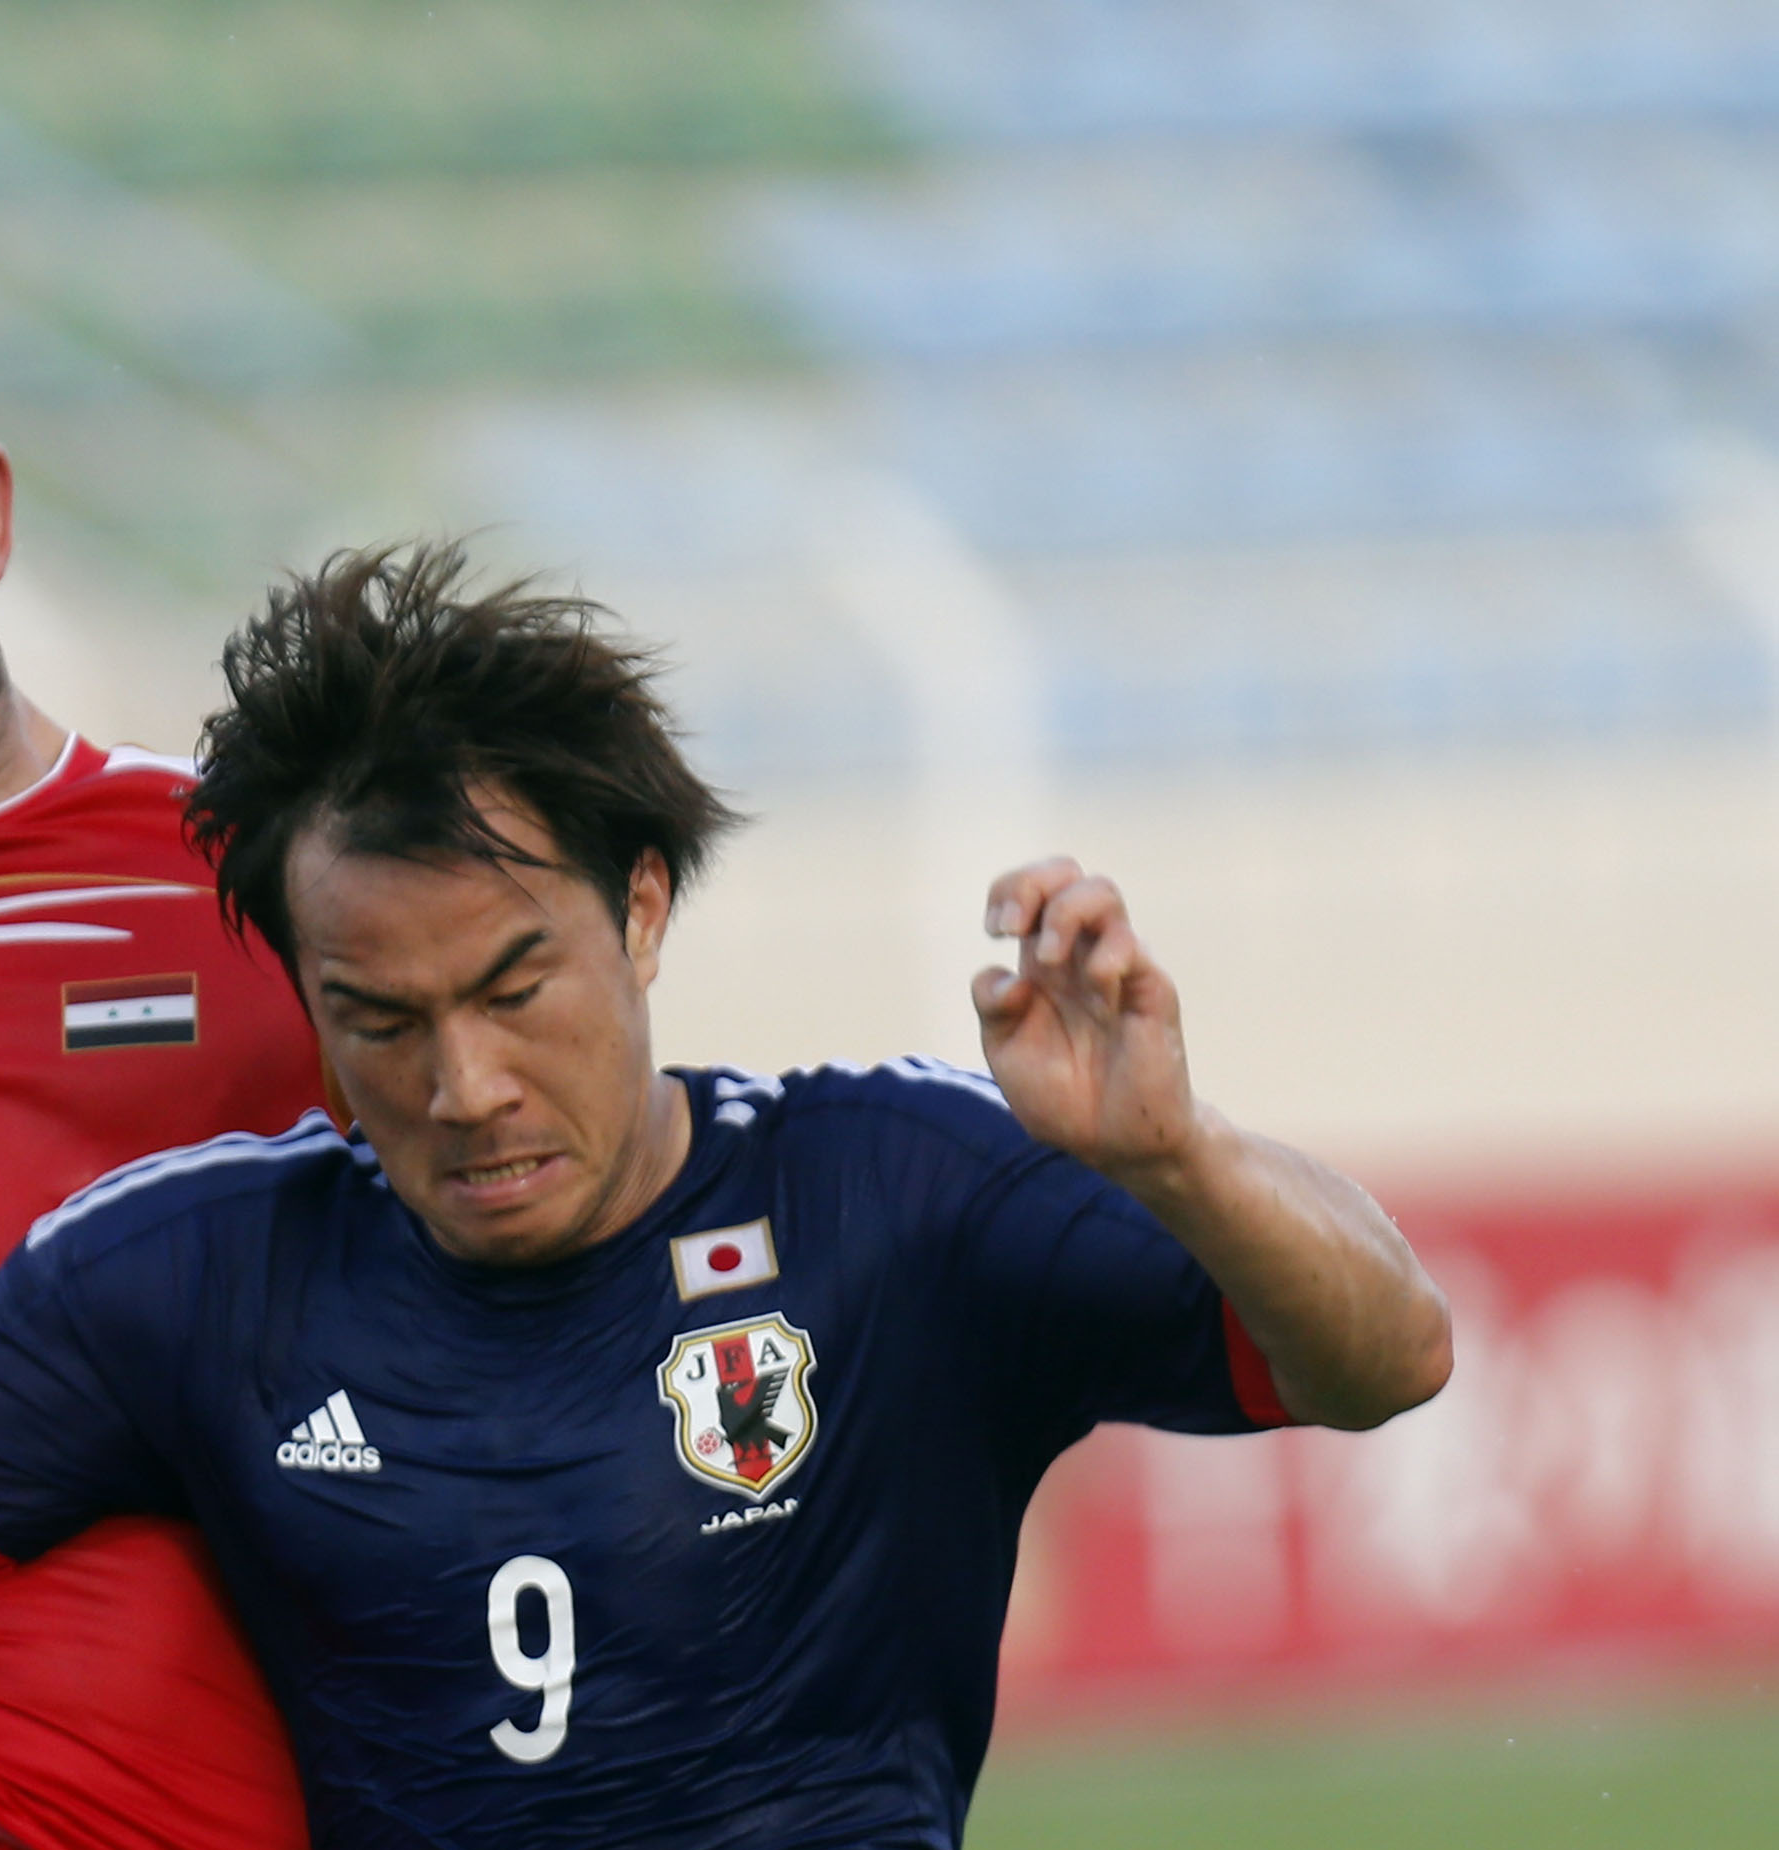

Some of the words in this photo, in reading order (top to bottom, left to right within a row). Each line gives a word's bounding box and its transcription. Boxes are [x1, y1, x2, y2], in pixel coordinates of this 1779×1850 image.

[686, 1337, 787, 1381] JFA
[276, 1440, 382, 1472] adidas
[488, 1555, 575, 1763] 9
